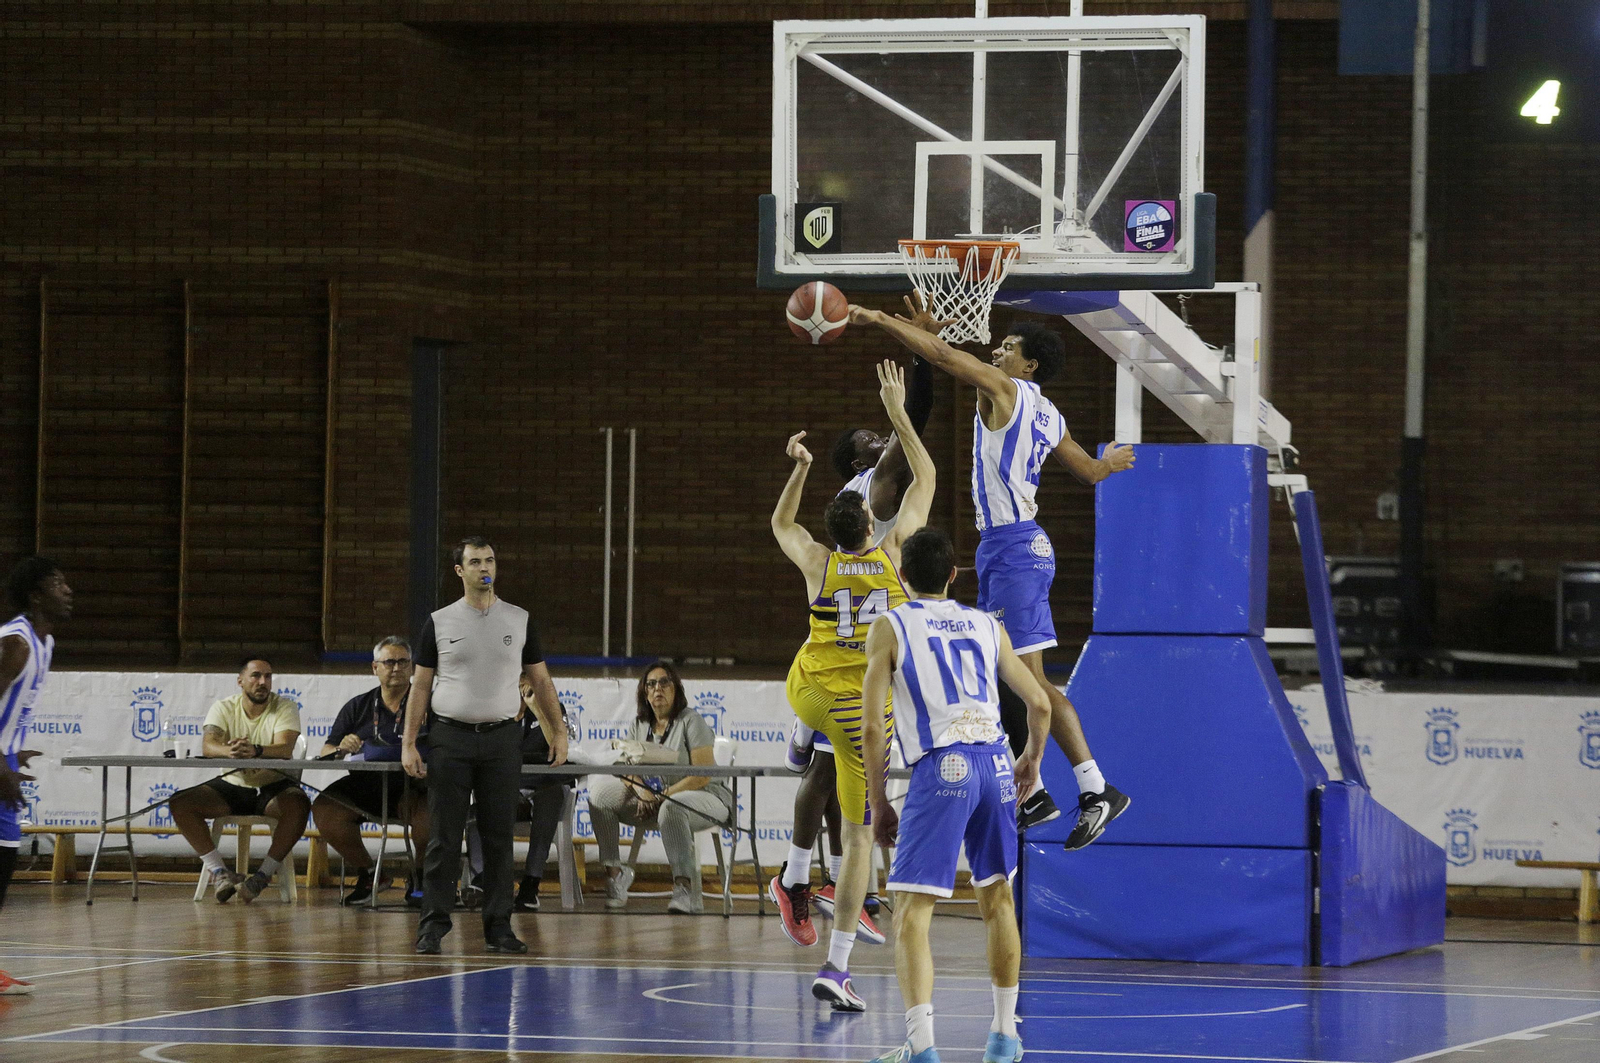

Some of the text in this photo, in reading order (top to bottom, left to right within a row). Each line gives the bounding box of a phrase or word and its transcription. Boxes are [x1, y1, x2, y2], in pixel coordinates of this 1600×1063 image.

[1520, 80, 1560, 124] 4
[1136, 213, 1157, 226] EBA
[809, 215, 827, 240] 100
[1136, 225, 1165, 238] FINAL
[832, 587, 889, 638] 14
[925, 618, 976, 632] MOREIRA
[927, 636, 988, 706] 10
[730, 730, 786, 743] HUELVA
[1464, 747, 1524, 760] HUELVA
[935, 788, 968, 799] AONES
[1483, 848, 1544, 861] HUELVA
